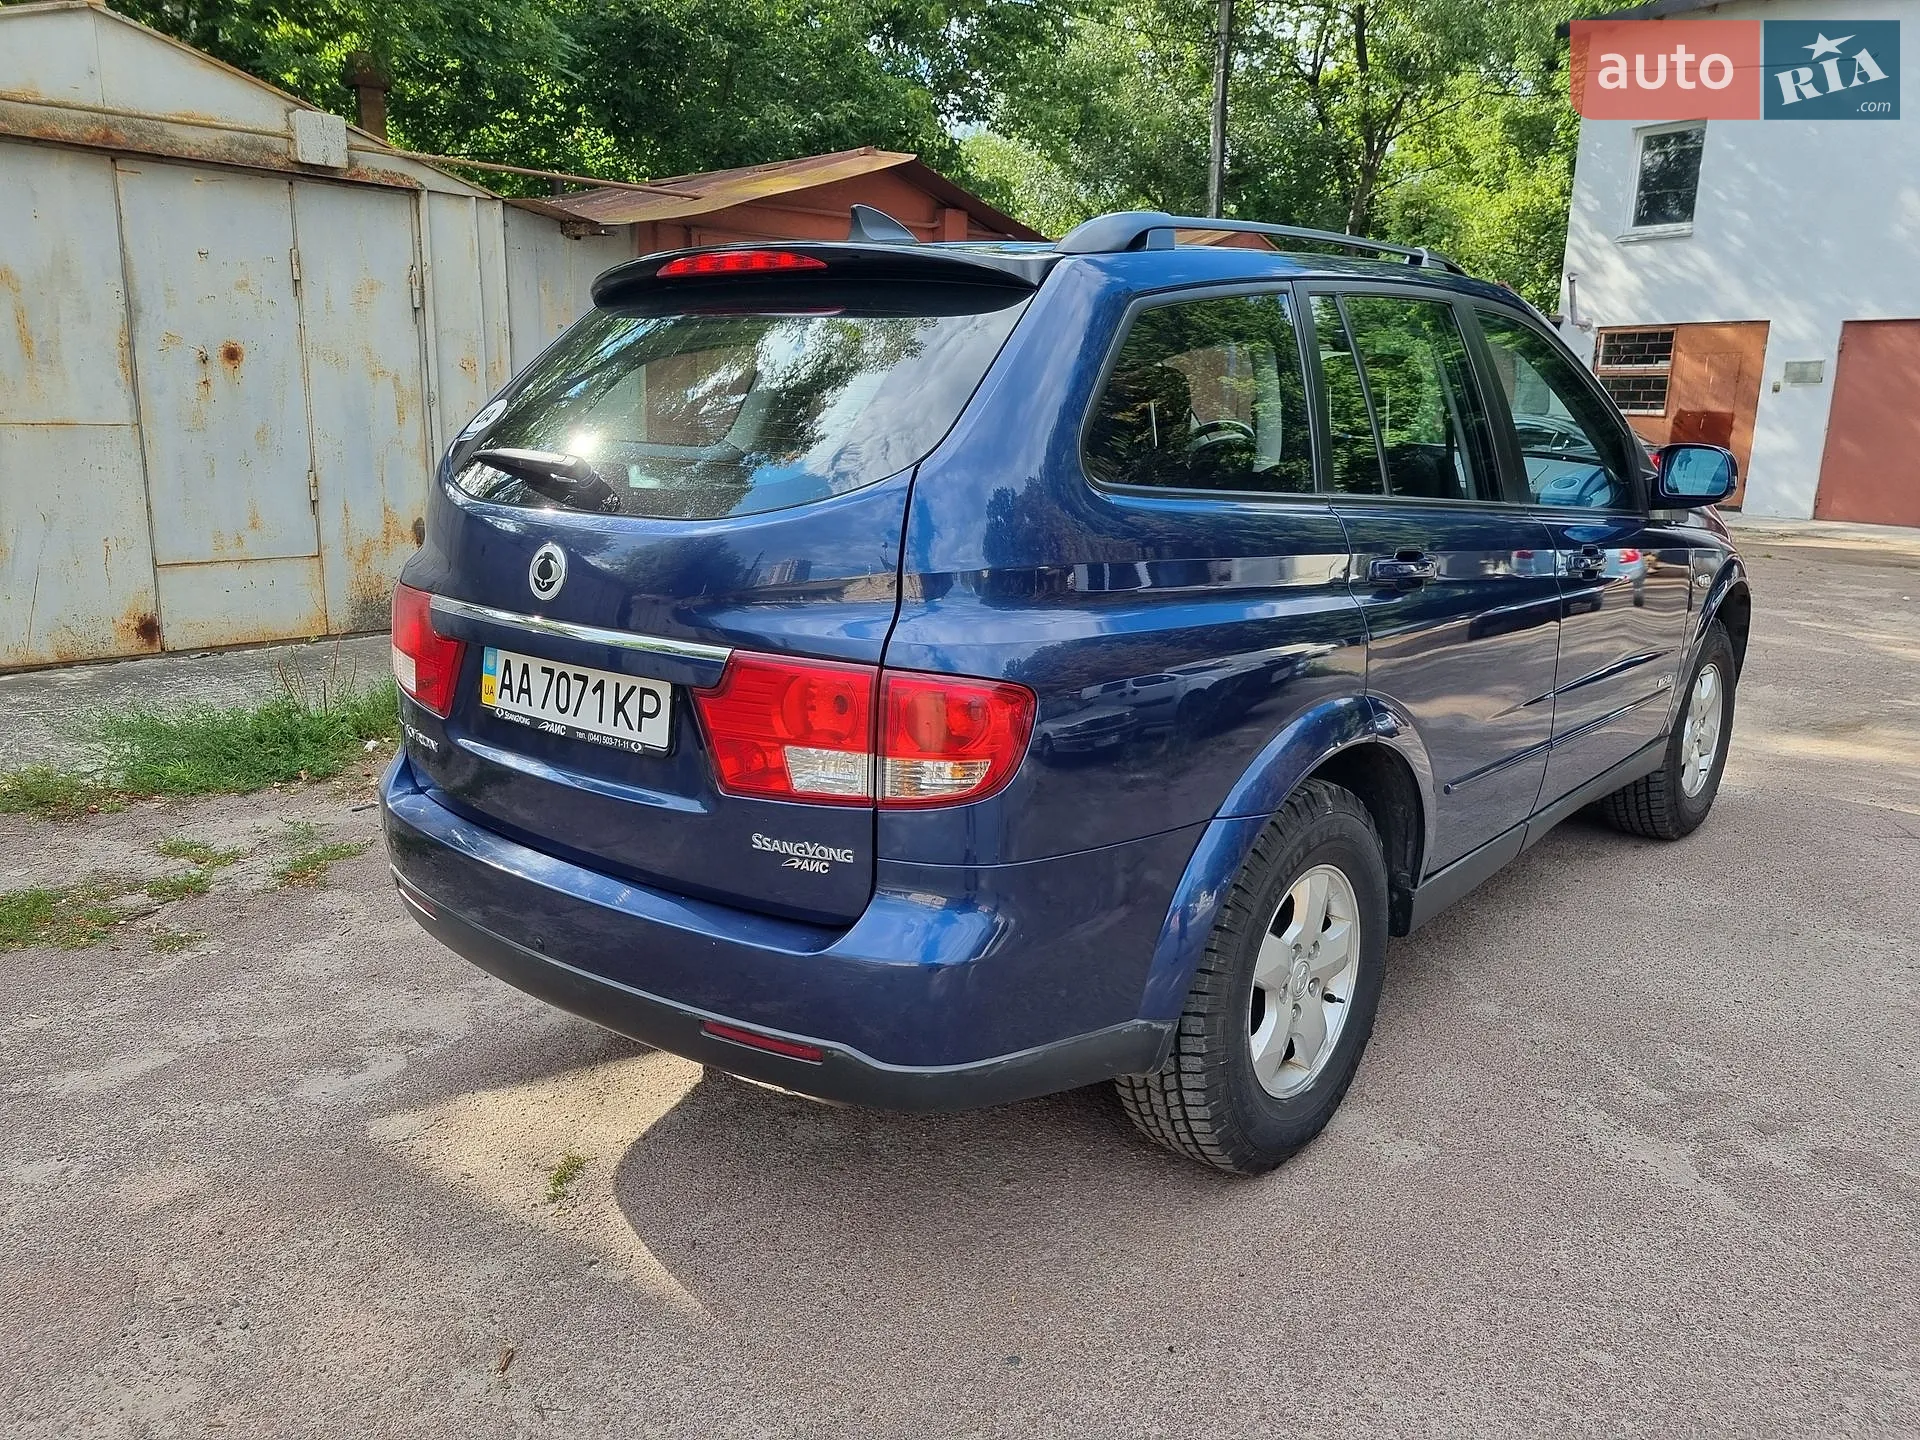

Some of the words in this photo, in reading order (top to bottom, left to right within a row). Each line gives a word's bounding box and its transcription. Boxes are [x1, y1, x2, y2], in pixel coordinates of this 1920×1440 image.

[484, 684, 495, 697] UA
[498, 658, 533, 708] AA
[540, 666, 606, 724] 7071
[613, 682, 662, 733] KP
[587, 732, 602, 745] (044)
[602, 736, 630, 749] 503-71-11
[800, 859, 830, 874] АИС
